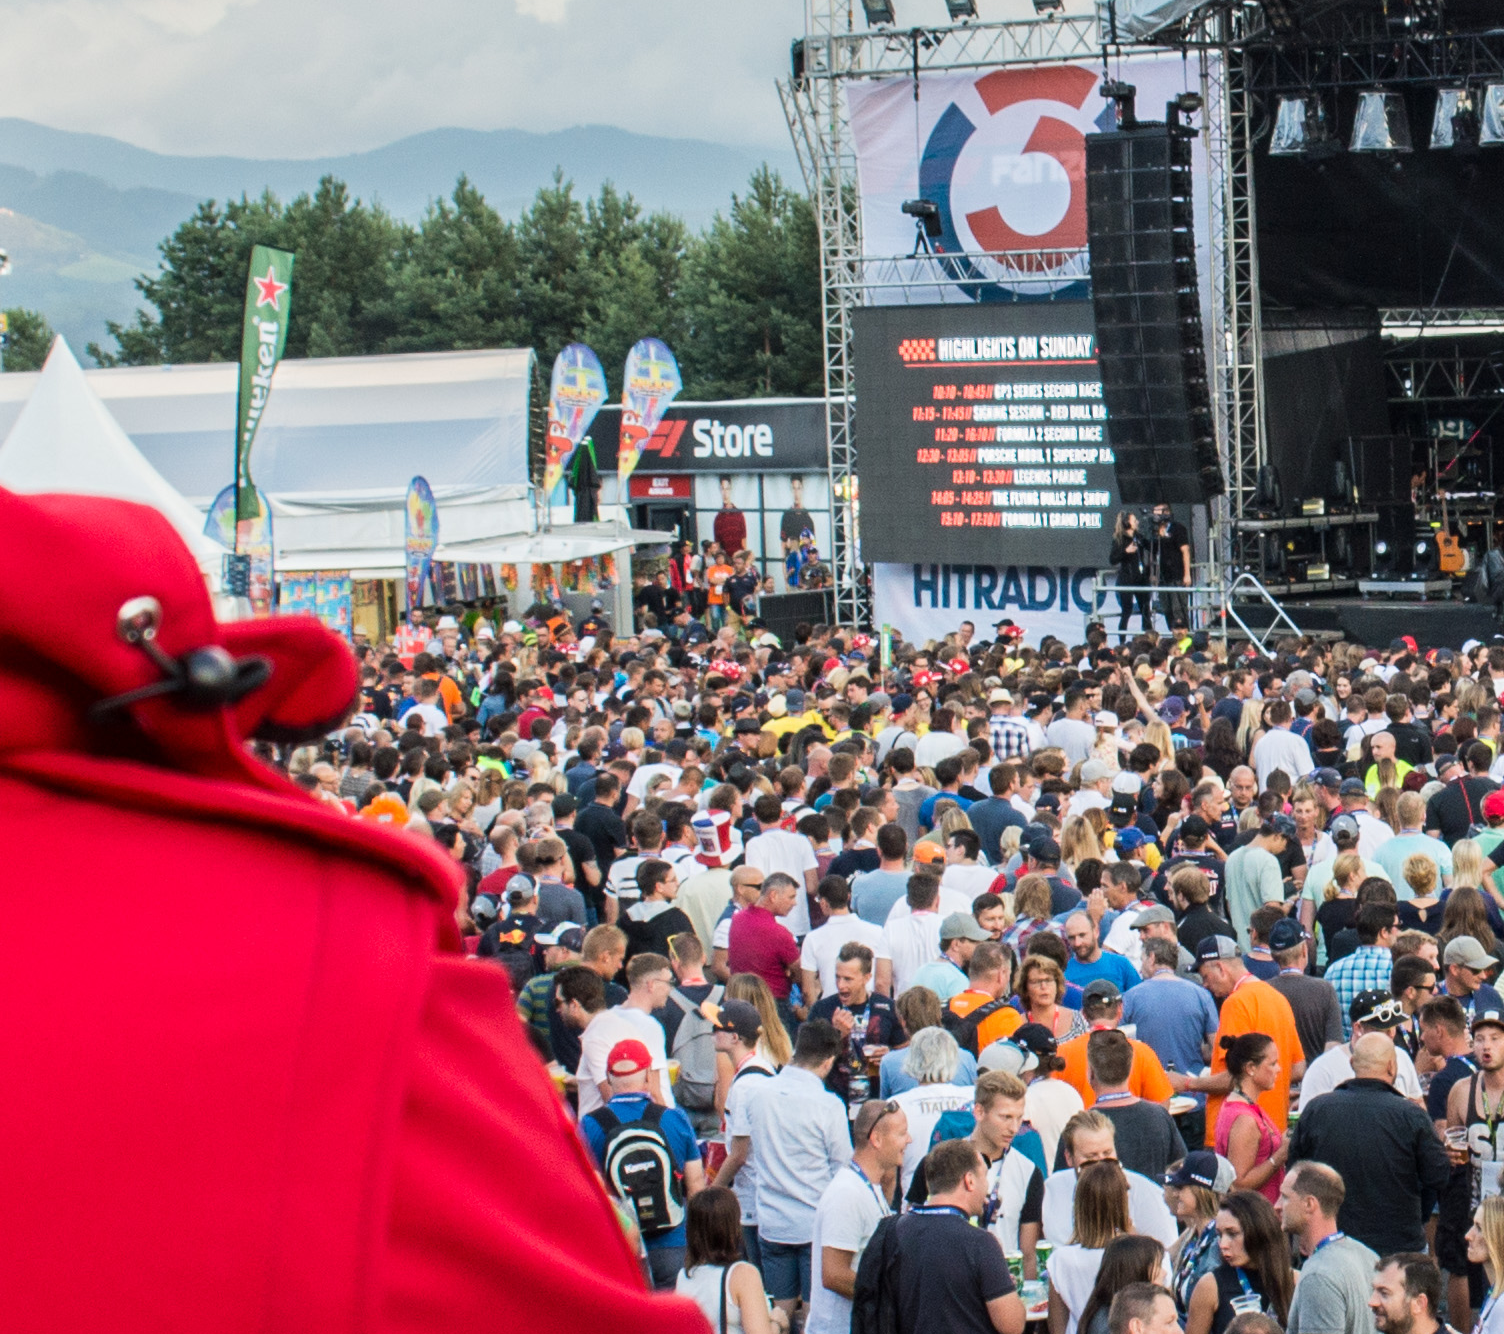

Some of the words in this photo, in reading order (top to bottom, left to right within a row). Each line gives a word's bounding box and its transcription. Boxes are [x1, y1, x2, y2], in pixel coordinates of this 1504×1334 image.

[938, 336, 1016, 361] HIGHLIGHTS
[1018, 335, 1038, 359] ON
[1040, 334, 1094, 359] SUNDAY
[692, 418, 774, 458] Store
[913, 563, 1107, 612] HITRADIO
